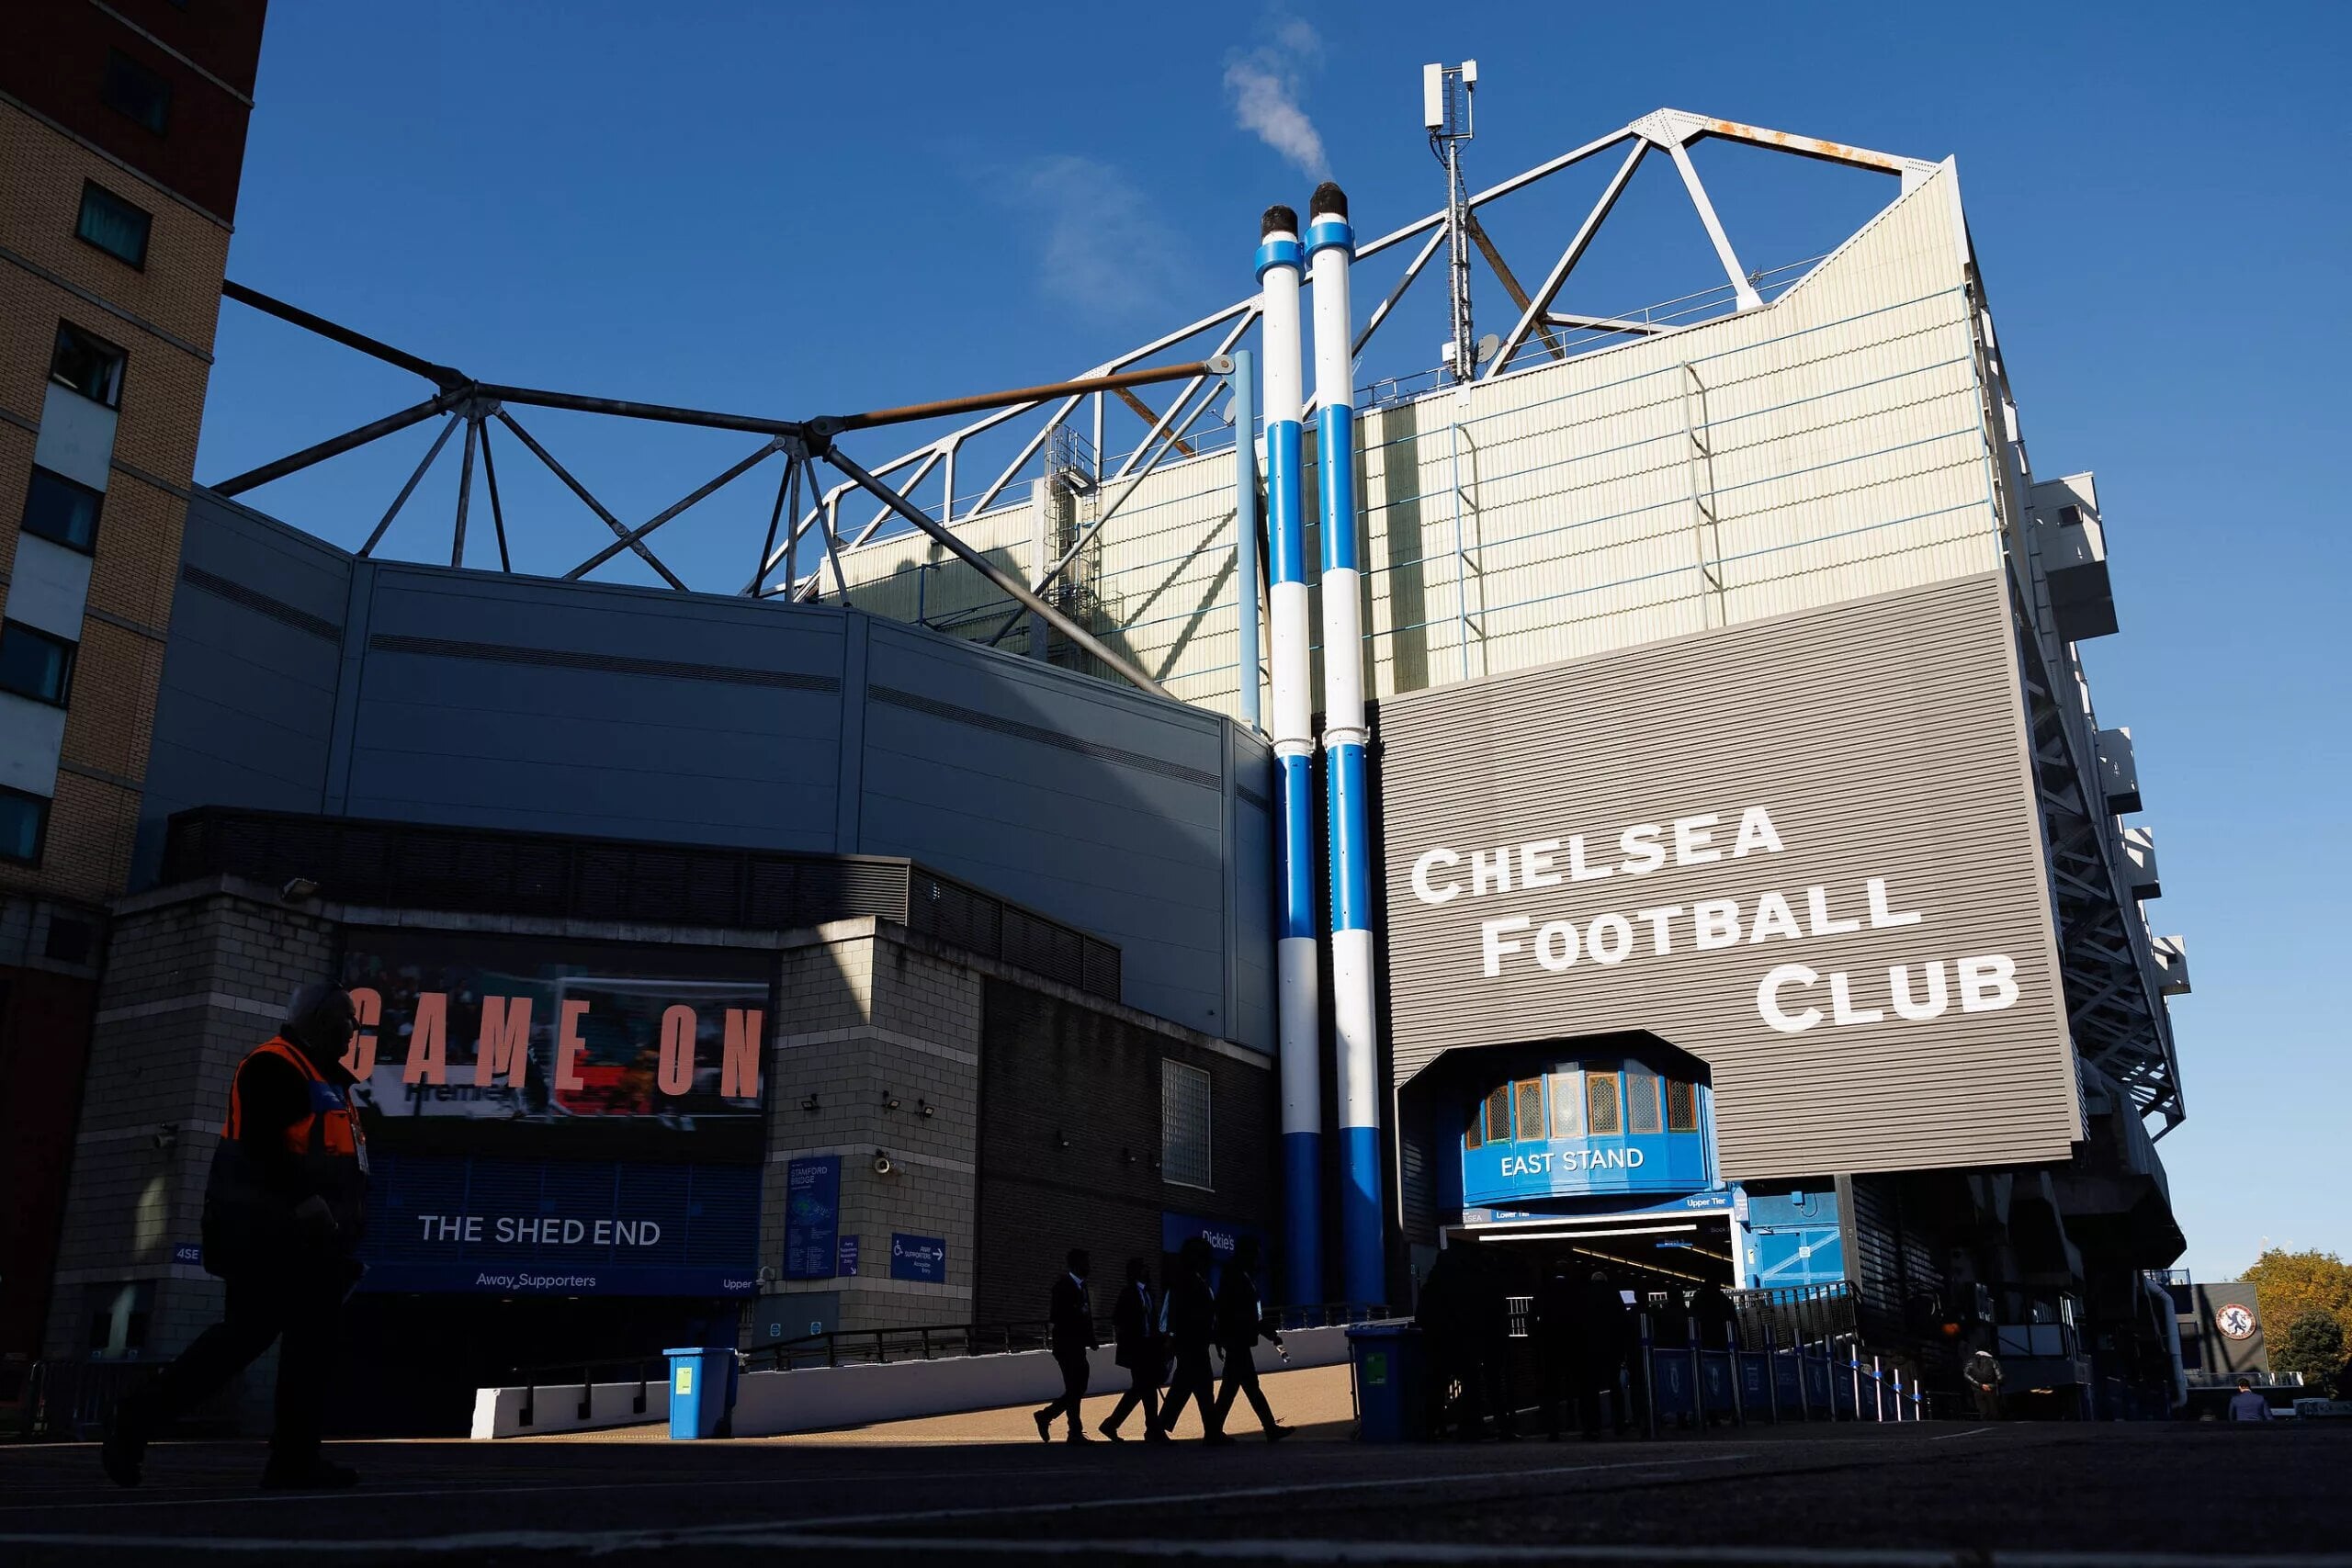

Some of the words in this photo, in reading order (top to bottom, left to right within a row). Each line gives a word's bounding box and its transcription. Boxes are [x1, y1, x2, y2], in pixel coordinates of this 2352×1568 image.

[1411, 806, 1784, 905] CHELSEA
[1480, 877, 1921, 977] FOOTBALL
[1757, 953, 2020, 1033] CLUB
[338, 987, 590, 1090] GAME
[658, 1004, 763, 1098] ON
[1501, 1152, 1555, 1177] EAST
[1563, 1148, 1644, 1171] STAND
[1496, 1211, 1517, 1219] Lower
[1687, 1198, 1710, 1208] Upper
[1711, 1197, 1726, 1205] Tier
[418, 1214, 484, 1242] THE
[495, 1216, 586, 1245] SHED
[594, 1219, 662, 1247] END
[1203, 1229, 1235, 1251] Dickie's
[176, 1247, 199, 1259] 4SE
[476, 1272, 514, 1289] Away
[518, 1273, 596, 1289] Supporters
[723, 1279, 752, 1291] Upper
